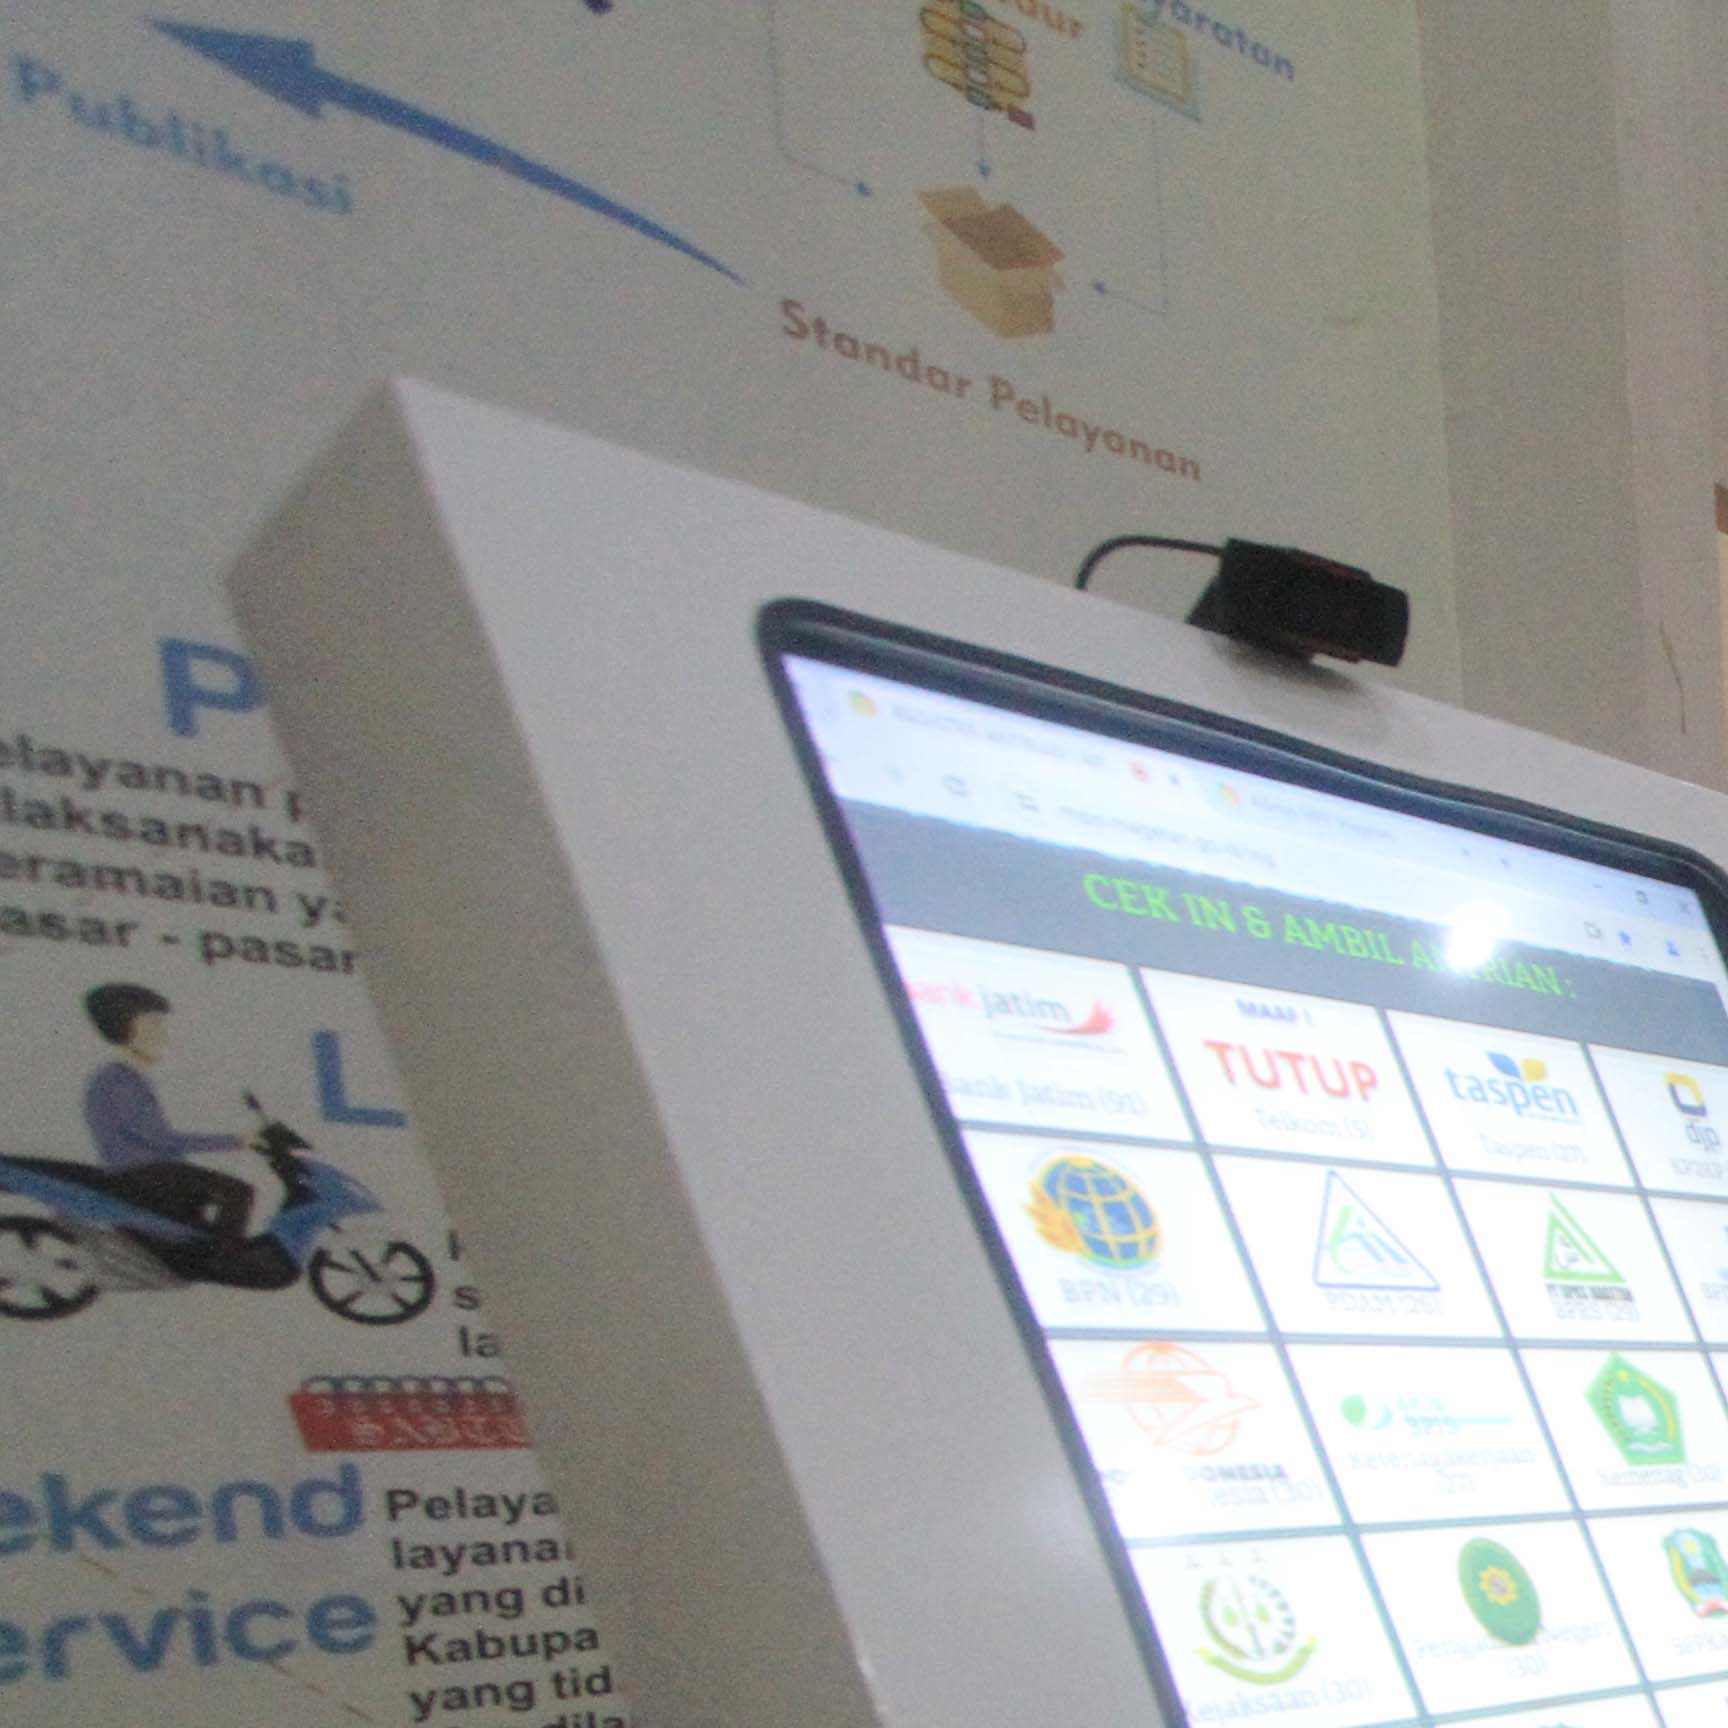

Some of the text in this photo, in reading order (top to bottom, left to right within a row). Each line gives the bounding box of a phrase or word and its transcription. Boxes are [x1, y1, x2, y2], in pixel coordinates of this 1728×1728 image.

[14, 55, 353, 215] Publikasi
[781, 299, 1200, 480] Standar Pelayanan
[1083, 873, 1180, 922] CEK
[1182, 892, 1237, 934] IN
[1239, 905, 1273, 940] &
[1284, 913, 1403, 965] AMBIL
[1412, 938, 1561, 996] ARIAN
[1201, 1037, 1379, 1103] TUTUP
[1443, 1066, 1580, 1120] taspen
[385, 1486, 558, 1533] Pelaya
[391, 1536, 575, 1577] layana
[398, 1575, 586, 1628] yang di
[403, 1624, 601, 1669] Kabupa
[408, 1665, 613, 1724] yang tid
